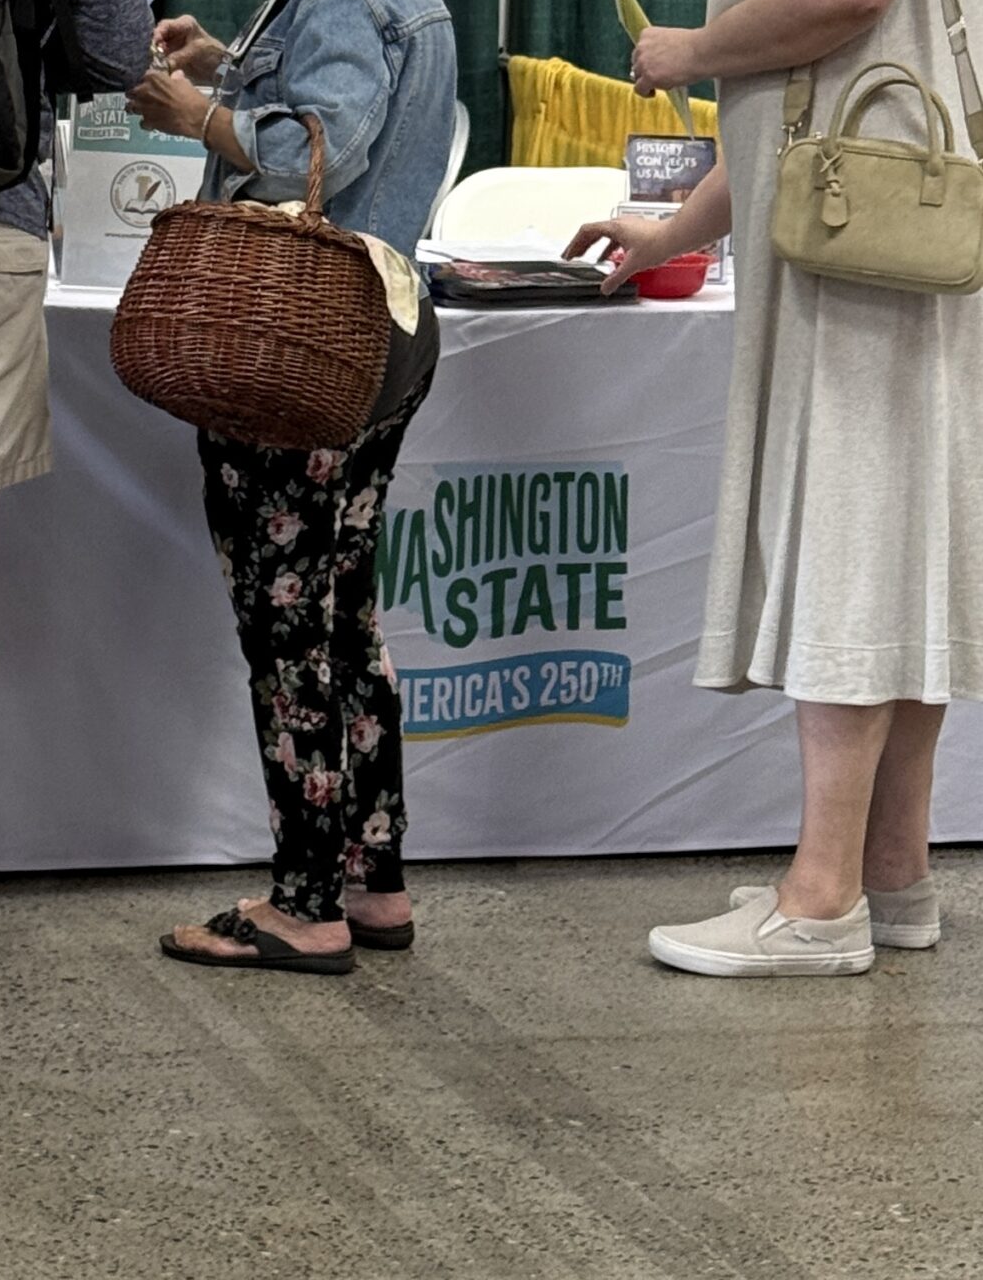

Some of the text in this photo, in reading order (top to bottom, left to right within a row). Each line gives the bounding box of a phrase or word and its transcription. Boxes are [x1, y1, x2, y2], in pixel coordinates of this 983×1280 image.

[636, 141, 684, 155] HISTORY
[636, 170, 652, 179] US
[443, 562, 628, 649] STATE
[540, 661, 623, 707] 250TH
